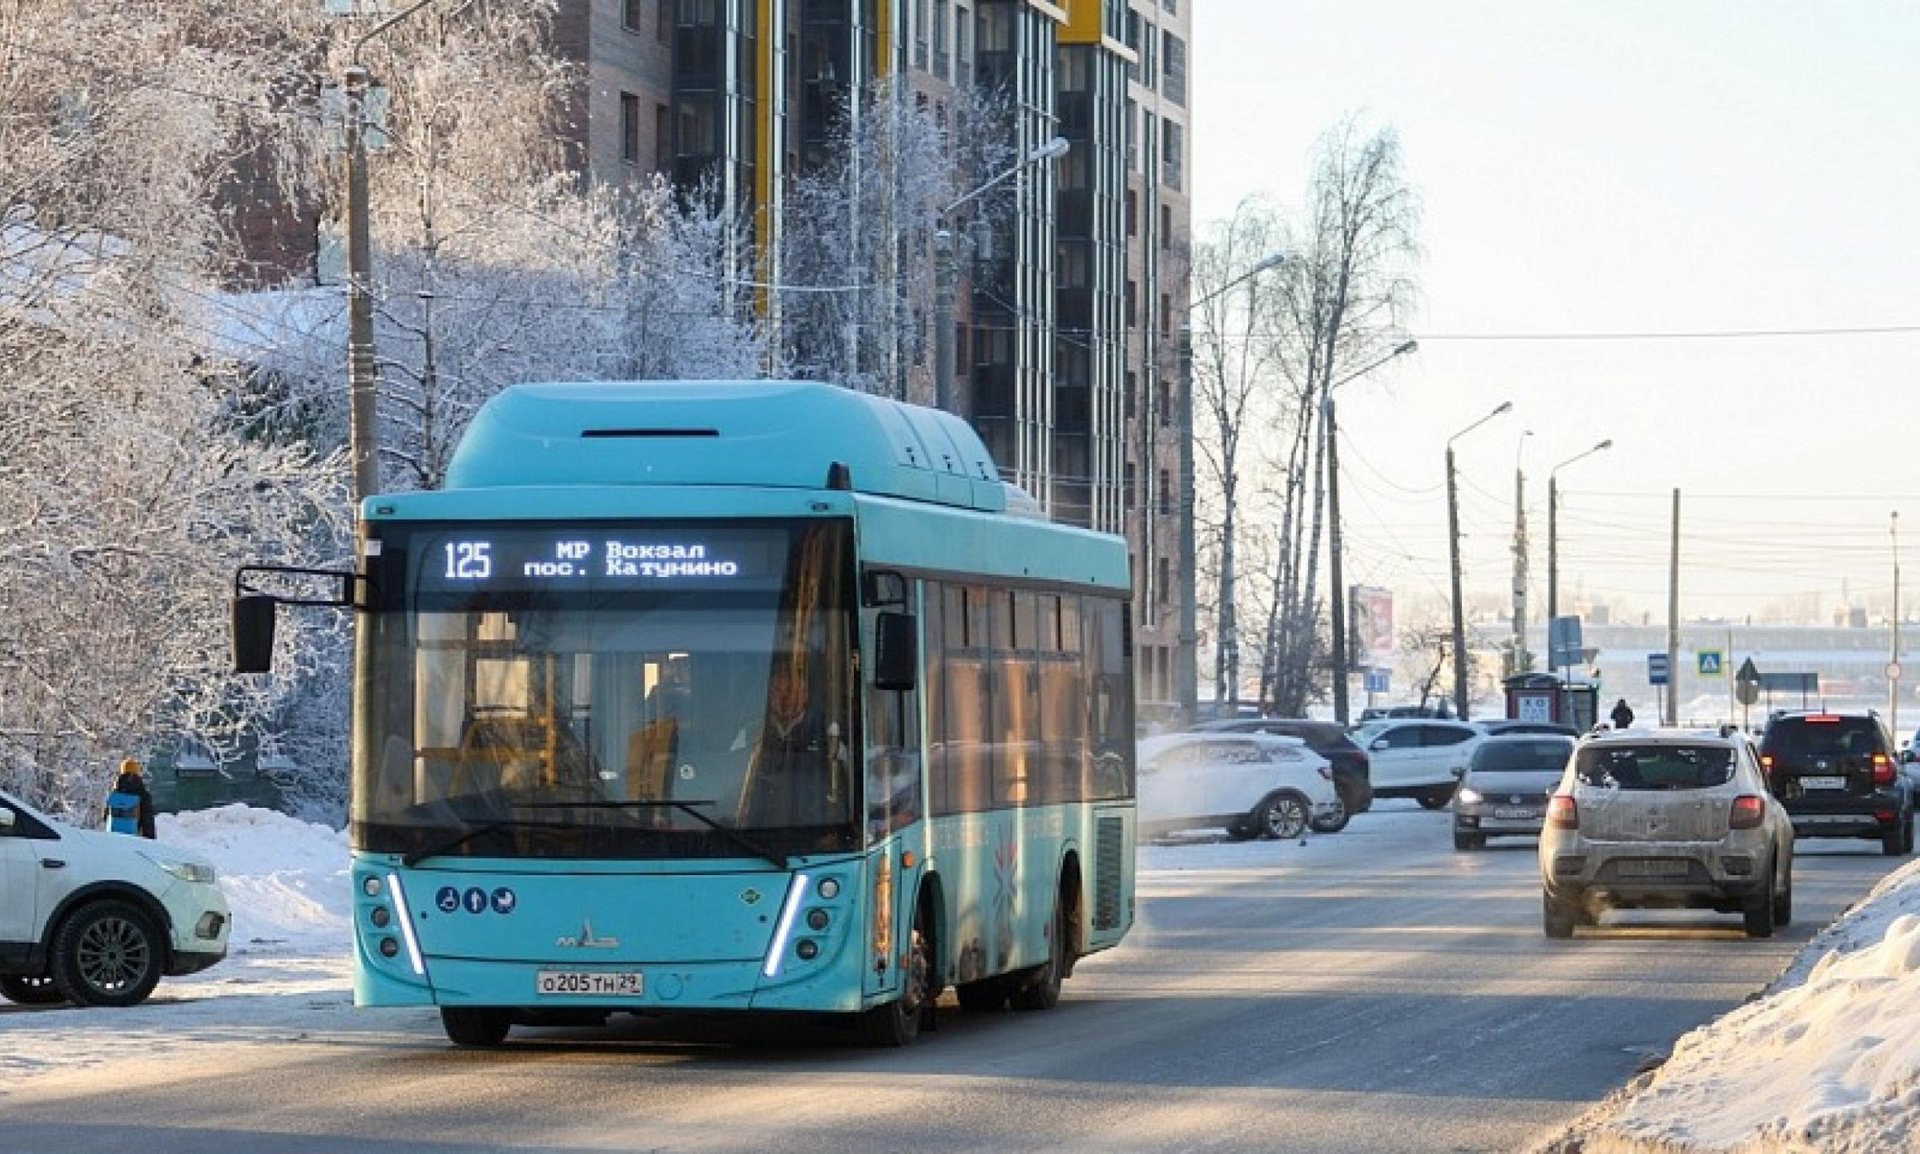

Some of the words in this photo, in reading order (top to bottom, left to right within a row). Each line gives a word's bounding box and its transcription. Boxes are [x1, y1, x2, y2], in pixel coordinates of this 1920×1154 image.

[556, 541, 590, 559] МР
[606, 541, 705, 559] Вокзал
[445, 542, 491, 578] 125
[524, 561, 587, 576] пос.
[606, 559, 738, 578] Катунино
